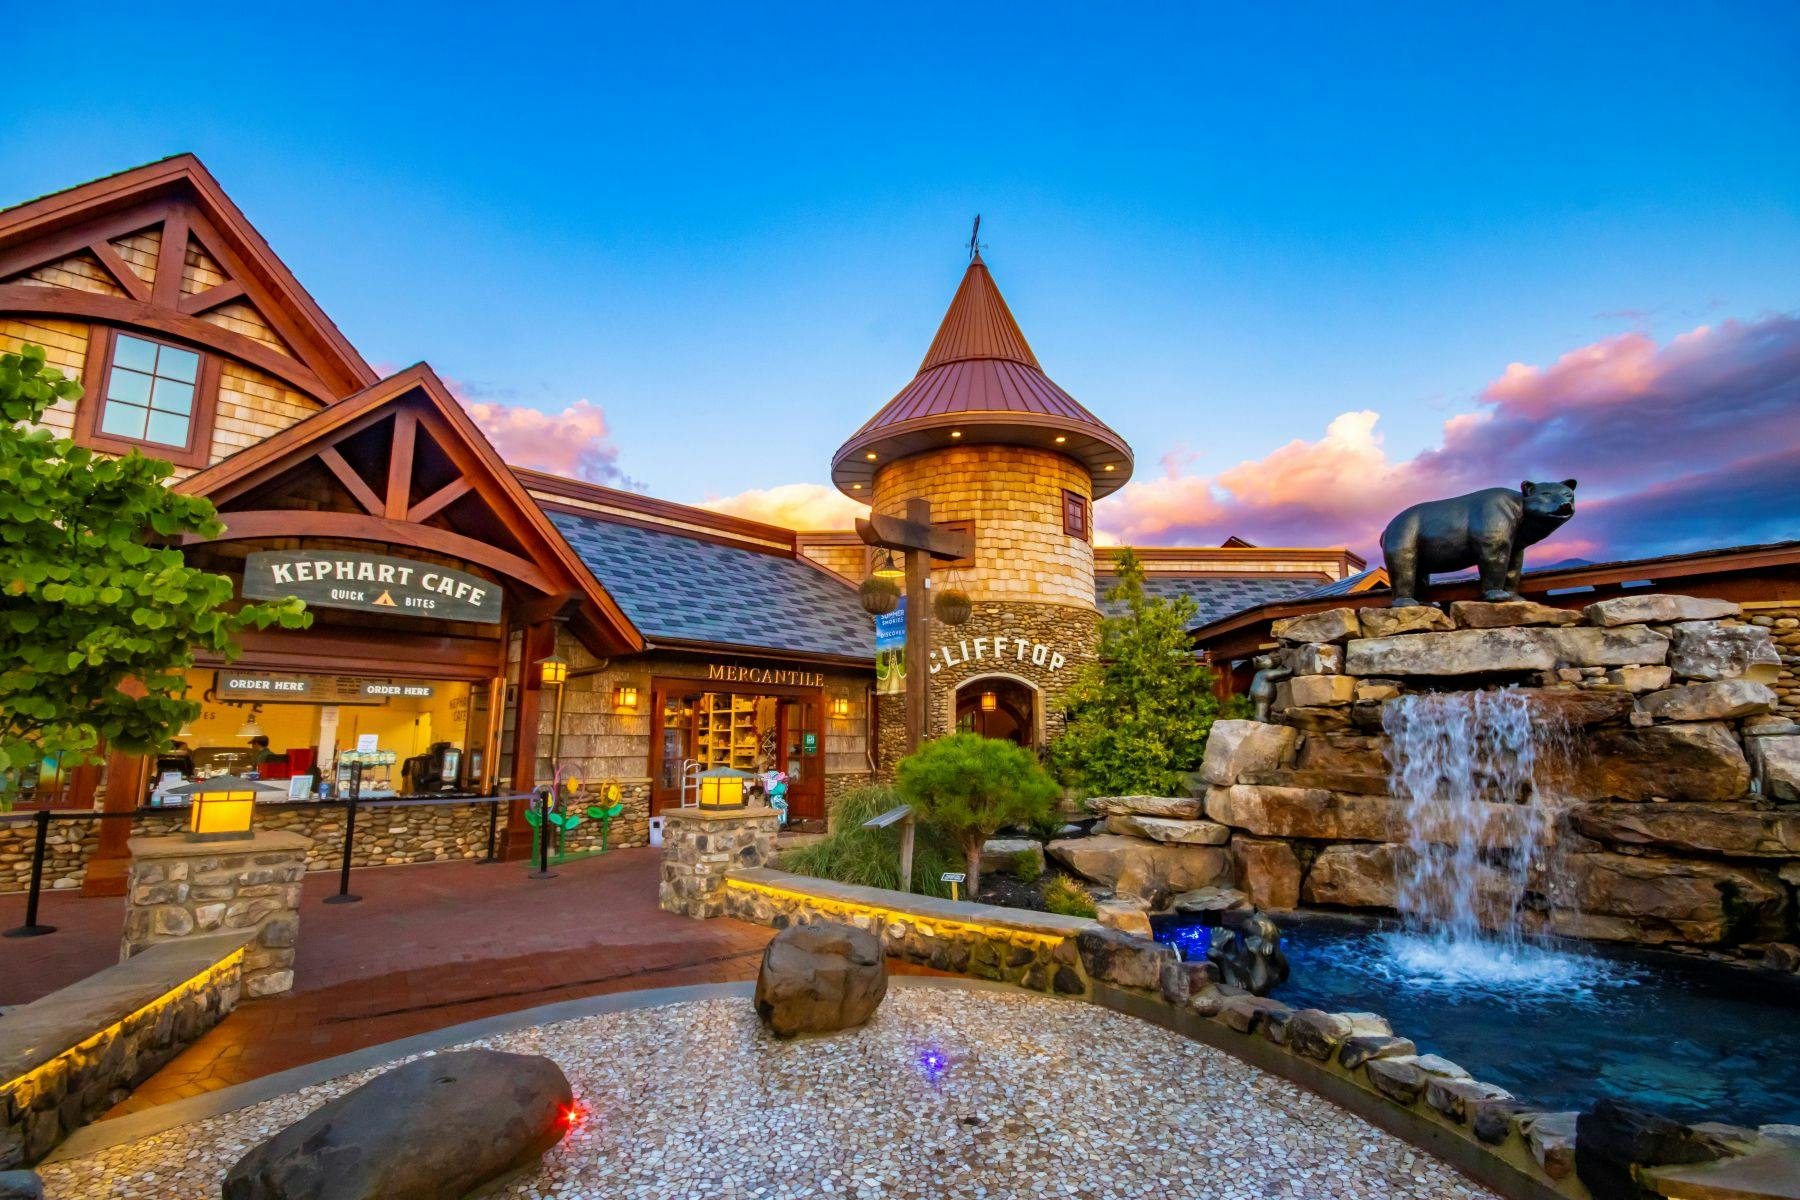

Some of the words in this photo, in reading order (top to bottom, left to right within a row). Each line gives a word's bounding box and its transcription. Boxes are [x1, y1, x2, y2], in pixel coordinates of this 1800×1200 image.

[271, 561, 413, 586] KEPHART
[421, 573, 485, 606] CAFE
[331, 588, 364, 601] QUICK
[405, 597, 435, 609] BITES
[929, 635, 1066, 674] CLIFFTOP
[229, 680, 270, 690] ORDER
[274, 681, 304, 691] HERE
[708, 663, 824, 687] MERCANTILE
[367, 685, 401, 695] ORDER
[404, 687, 430, 696] HERE
